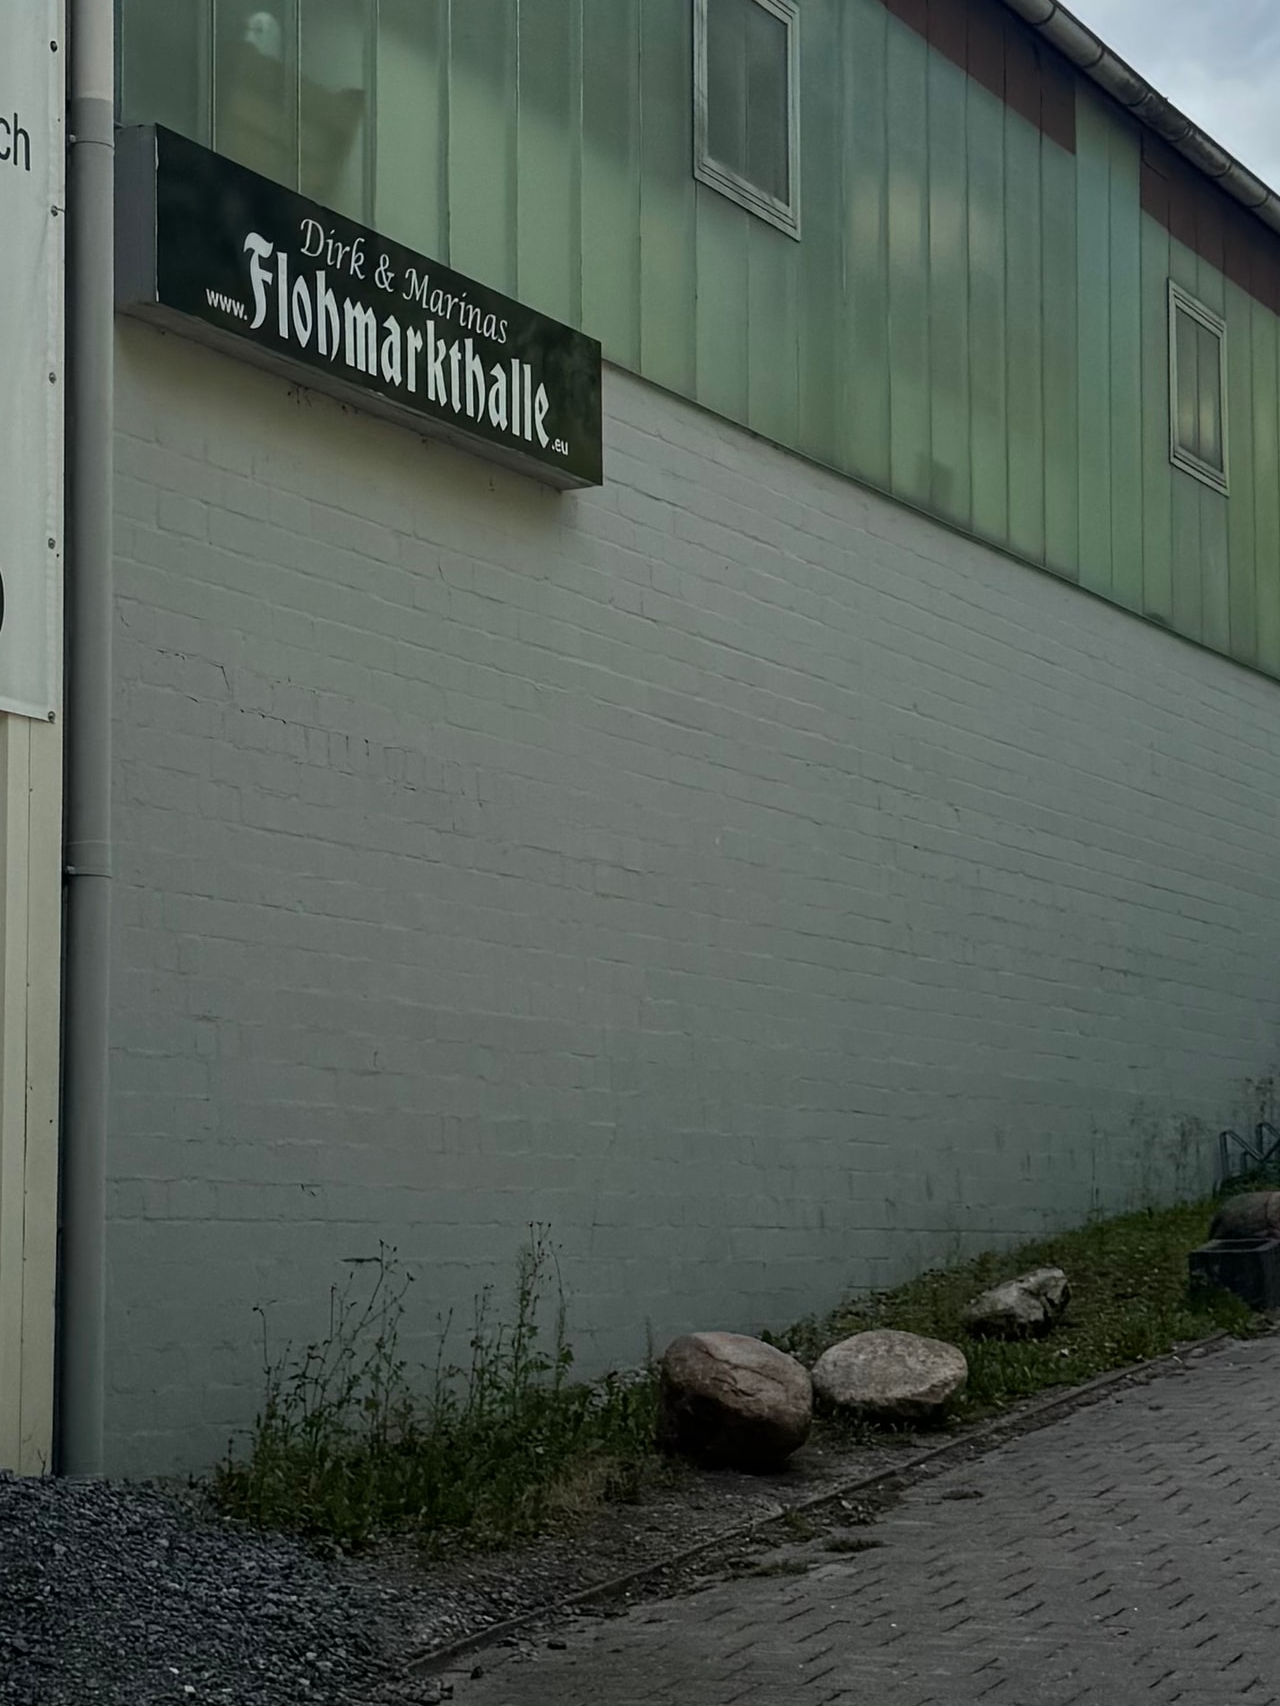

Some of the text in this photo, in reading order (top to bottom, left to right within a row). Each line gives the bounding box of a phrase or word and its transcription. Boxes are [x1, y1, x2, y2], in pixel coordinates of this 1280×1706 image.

[301, 218, 509, 345] Dirk & Marinas
